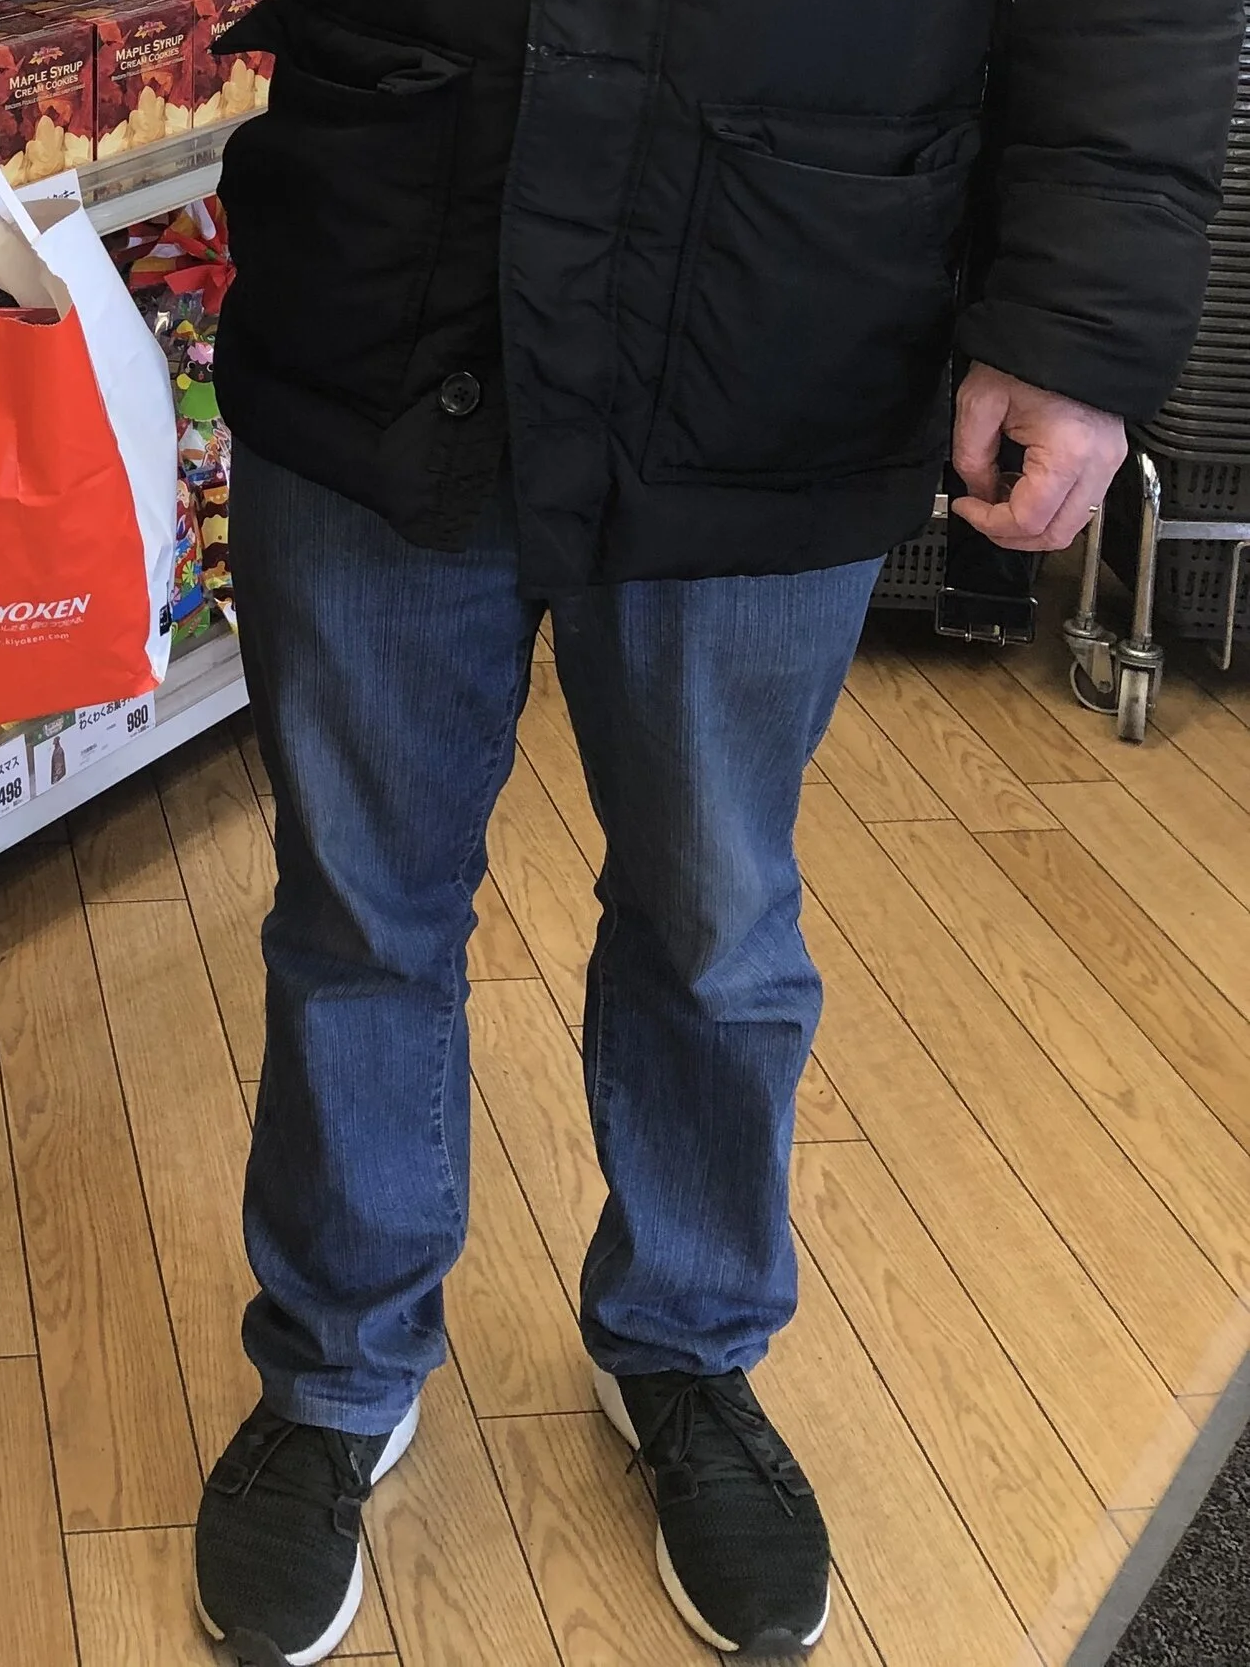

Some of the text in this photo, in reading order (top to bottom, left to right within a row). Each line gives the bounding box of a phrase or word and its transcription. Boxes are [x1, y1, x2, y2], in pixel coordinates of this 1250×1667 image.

[115, 34, 185, 62] MAPLE SYRUP
[120, 47, 180, 71] CREAM COOKIES
[9, 60, 84, 90] MAPLE SYRUP
[14, 74, 79, 99] CREAM COOKIES
[126, 704, 149, 733] 980
